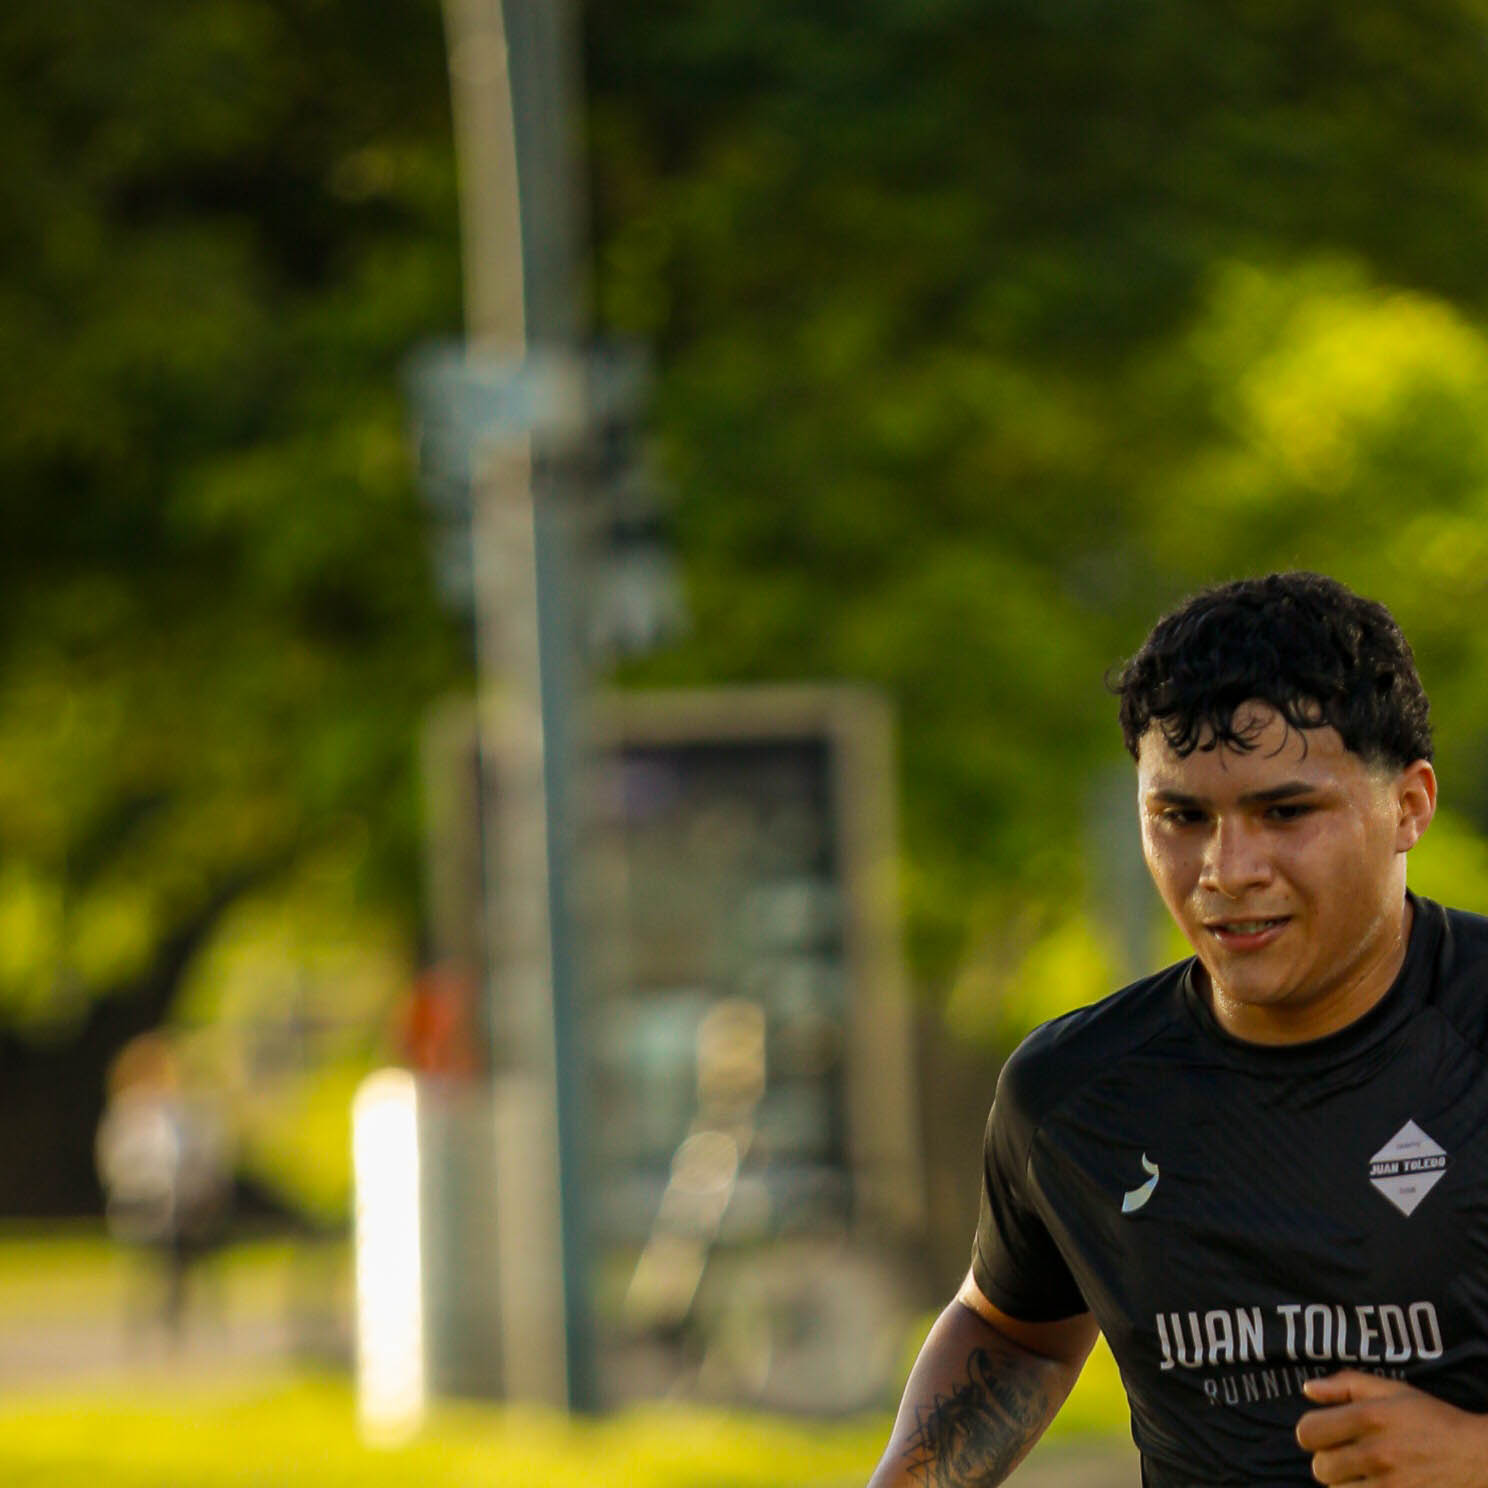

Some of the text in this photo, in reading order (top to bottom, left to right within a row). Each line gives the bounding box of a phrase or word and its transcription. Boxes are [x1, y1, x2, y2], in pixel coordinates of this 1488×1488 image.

[1370, 1157, 1447, 1176] JUAN TOLEDO
[1156, 1301, 1443, 1371] JUAN TOLEDO
